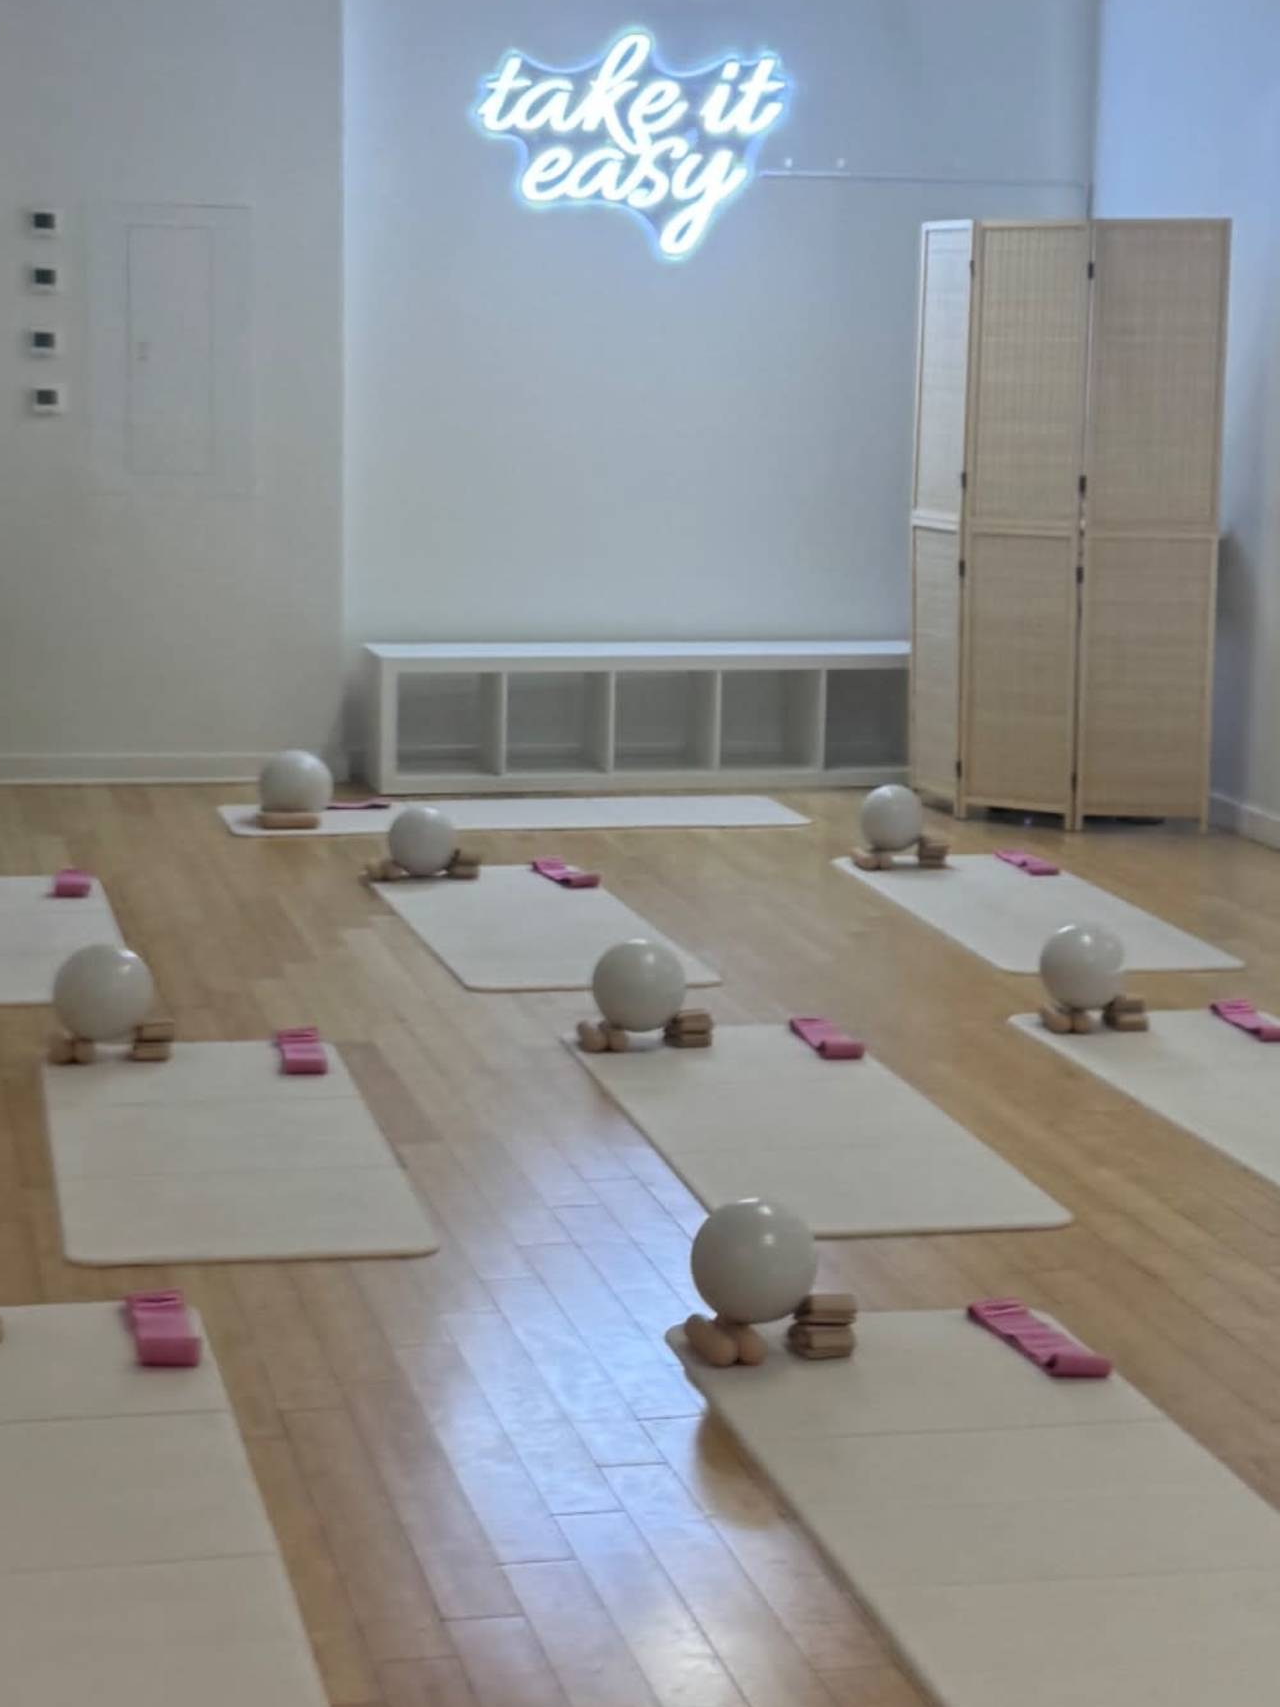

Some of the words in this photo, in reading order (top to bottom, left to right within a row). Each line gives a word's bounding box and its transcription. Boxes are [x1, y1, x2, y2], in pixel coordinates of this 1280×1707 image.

[477, 34, 689, 154] take
[699, 58, 786, 135] it
[520, 135, 748, 255] easy
